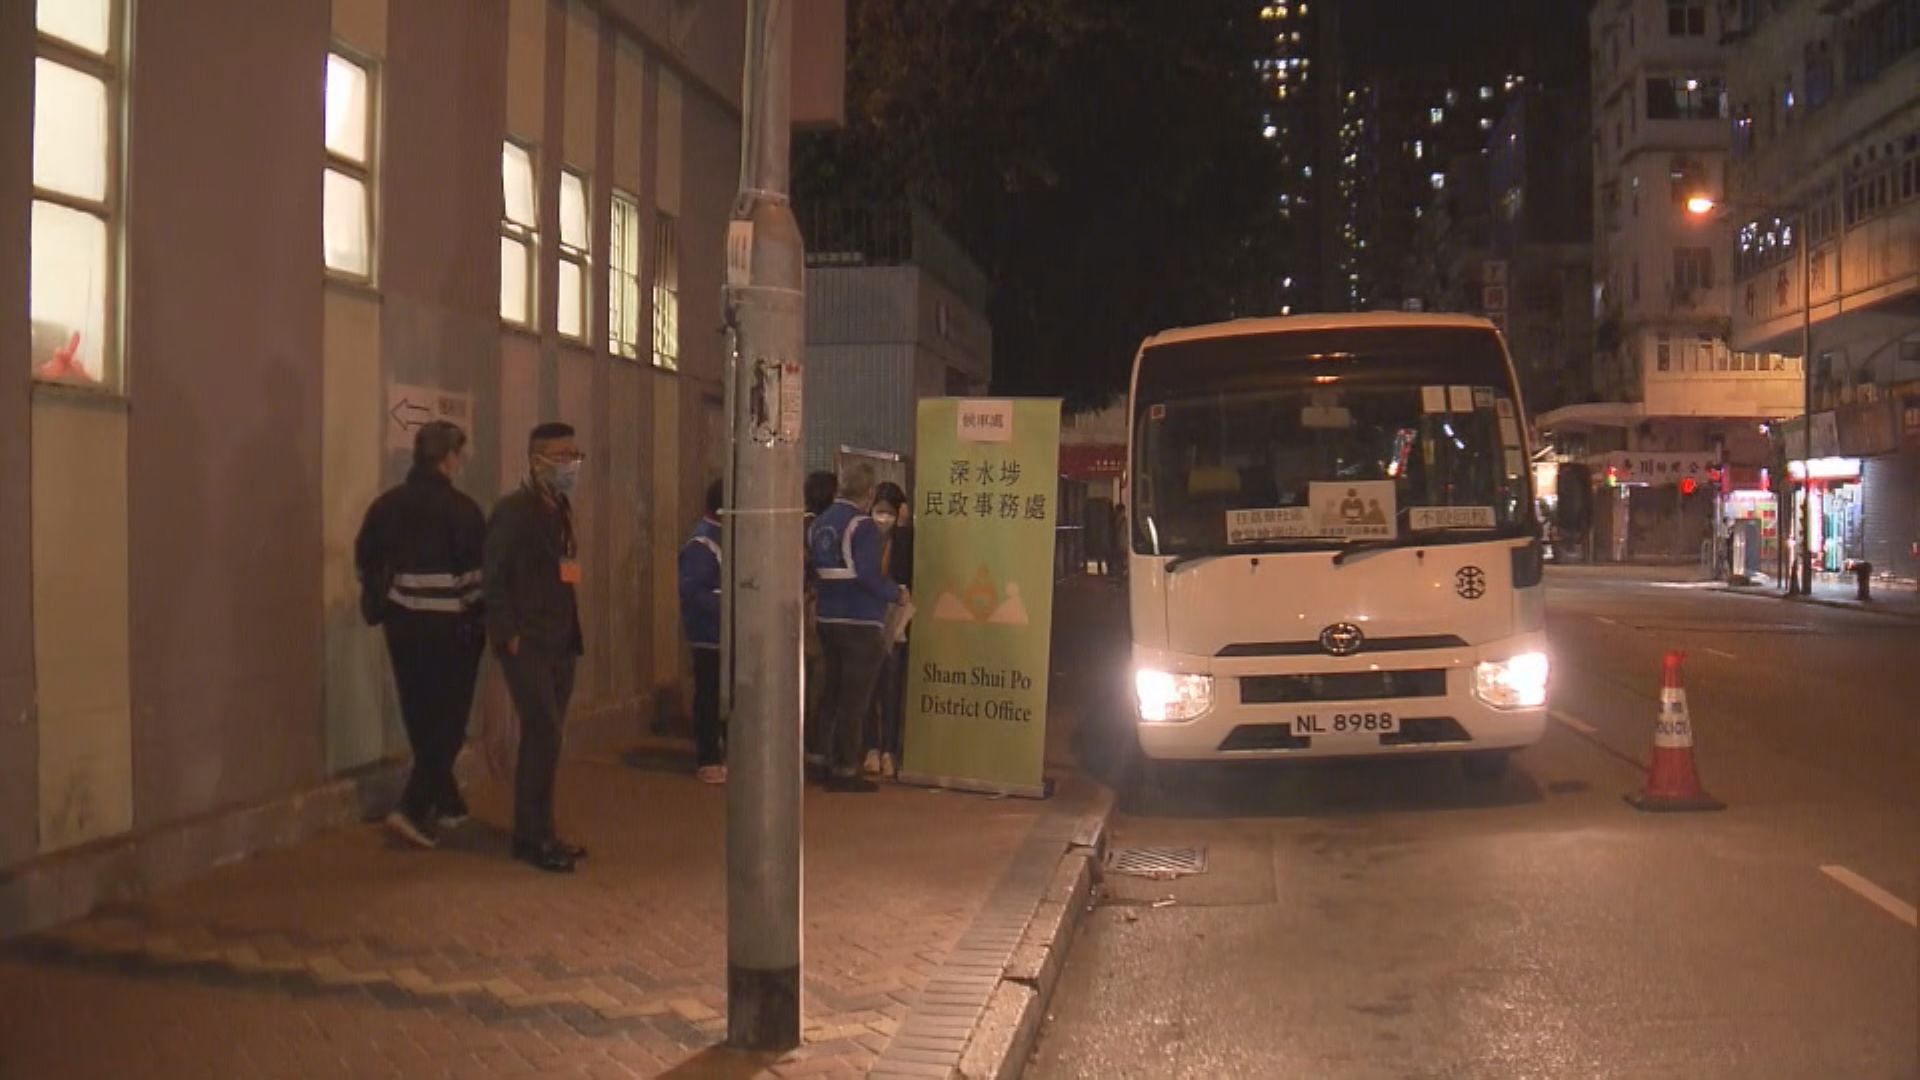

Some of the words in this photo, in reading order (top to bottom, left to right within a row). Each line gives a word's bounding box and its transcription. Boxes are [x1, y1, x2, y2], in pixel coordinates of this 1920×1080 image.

[950, 459, 1021, 486] 深水埗
[924, 490, 1046, 519] 民政事務處
[923, 662, 966, 685] Sham
[970, 666, 1005, 688] Shui
[1010, 669, 1031, 689] Po
[920, 694, 979, 718] District
[984, 699, 1032, 722] Office
[1297, 714, 1326, 732] NL
[1334, 712, 1393, 731] 8988
